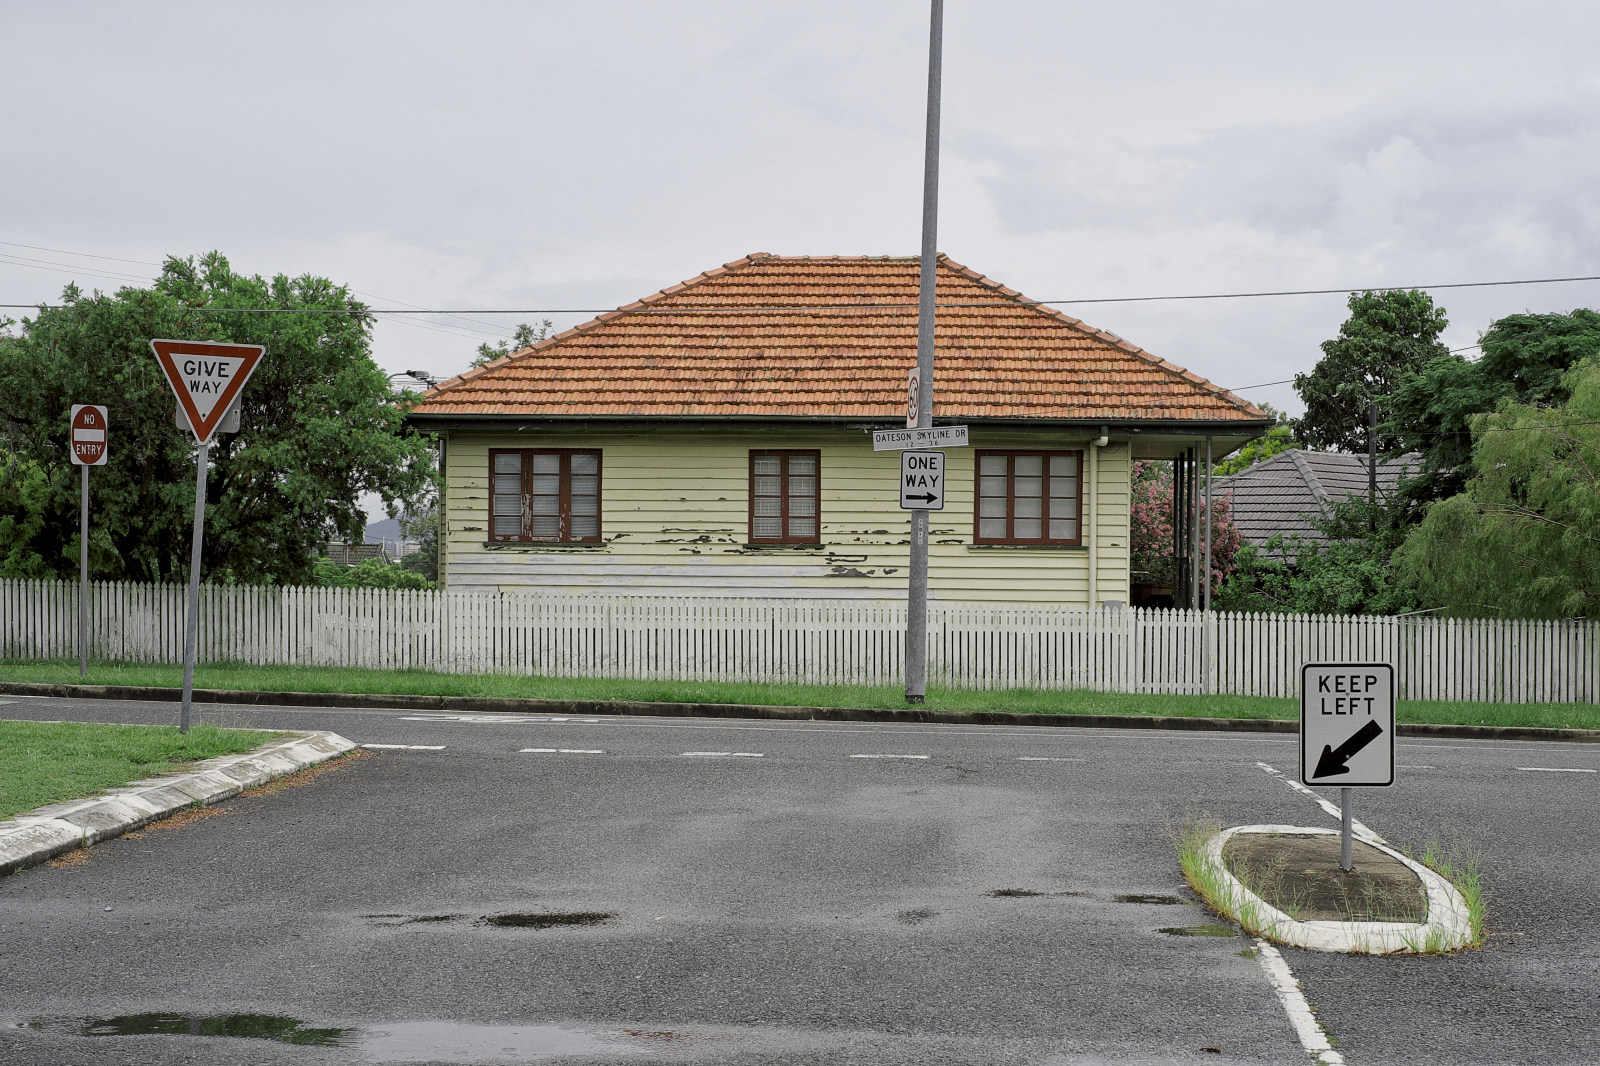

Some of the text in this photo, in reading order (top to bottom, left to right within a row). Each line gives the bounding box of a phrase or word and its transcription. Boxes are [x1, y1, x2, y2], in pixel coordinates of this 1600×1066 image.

[184, 360, 230, 378] GIVE
[190, 380, 221, 394] WAY
[84, 414, 95, 425] NO
[876, 429, 966, 442] OATESON SKYLINE DR
[76, 444, 102, 455] ENTRY
[908, 456, 937, 470] ONE
[905, 474, 939, 488] WAY
[1319, 675, 1378, 693] KEEP
[1321, 697, 1375, 715] LEFT
